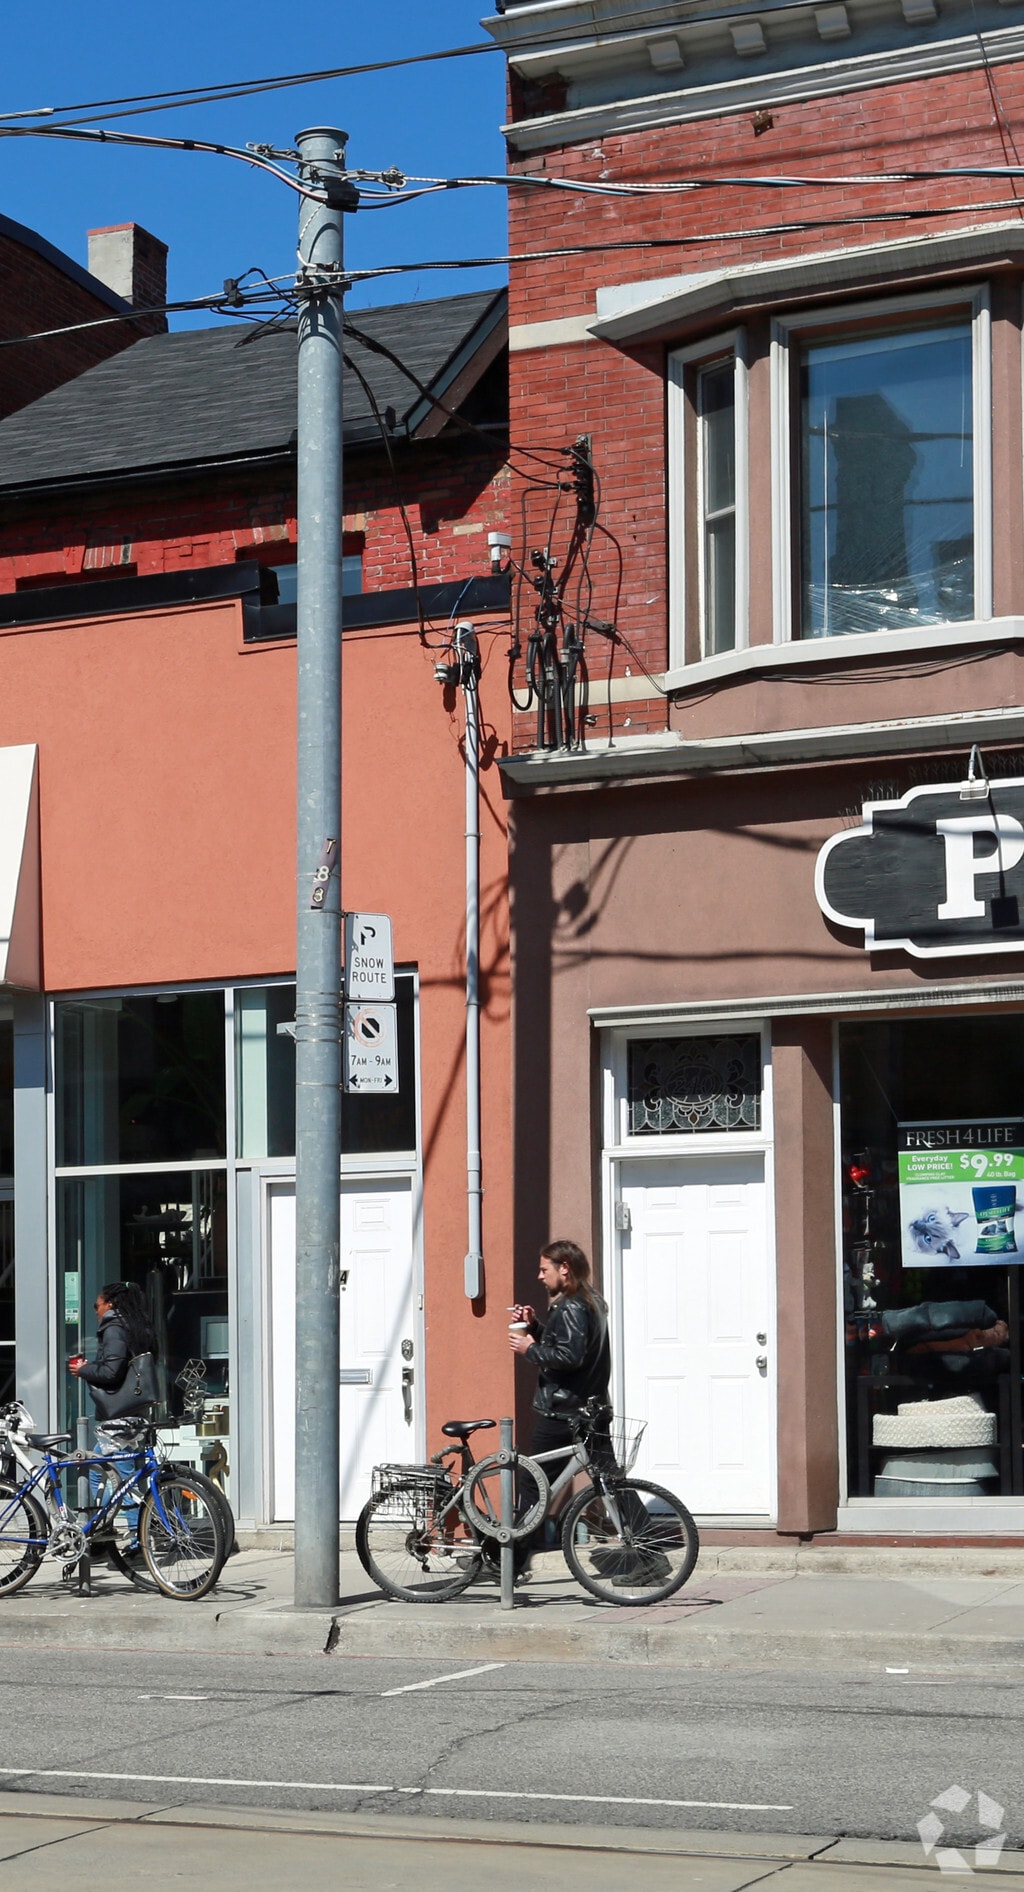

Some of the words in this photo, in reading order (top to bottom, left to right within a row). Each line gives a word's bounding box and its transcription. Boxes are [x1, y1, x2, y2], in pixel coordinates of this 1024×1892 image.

[354, 956, 384, 969] SNOW
[352, 971, 387, 984] ROUTE
[351, 1054, 367, 1066] 7AM
[375, 1054, 391, 1066] 9AM
[906, 1129, 961, 1148] FRESH
[963, 1128, 974, 1144] 4
[977, 1127, 1014, 1143] LIFE
[911, 1155, 949, 1164] Everyday
[960, 1153, 1014, 1178] $9.99
[907, 1163, 925, 1171] LOW
[927, 1162, 953, 1170] PRICE!
[1004, 1170, 1016, 1178] Bag
